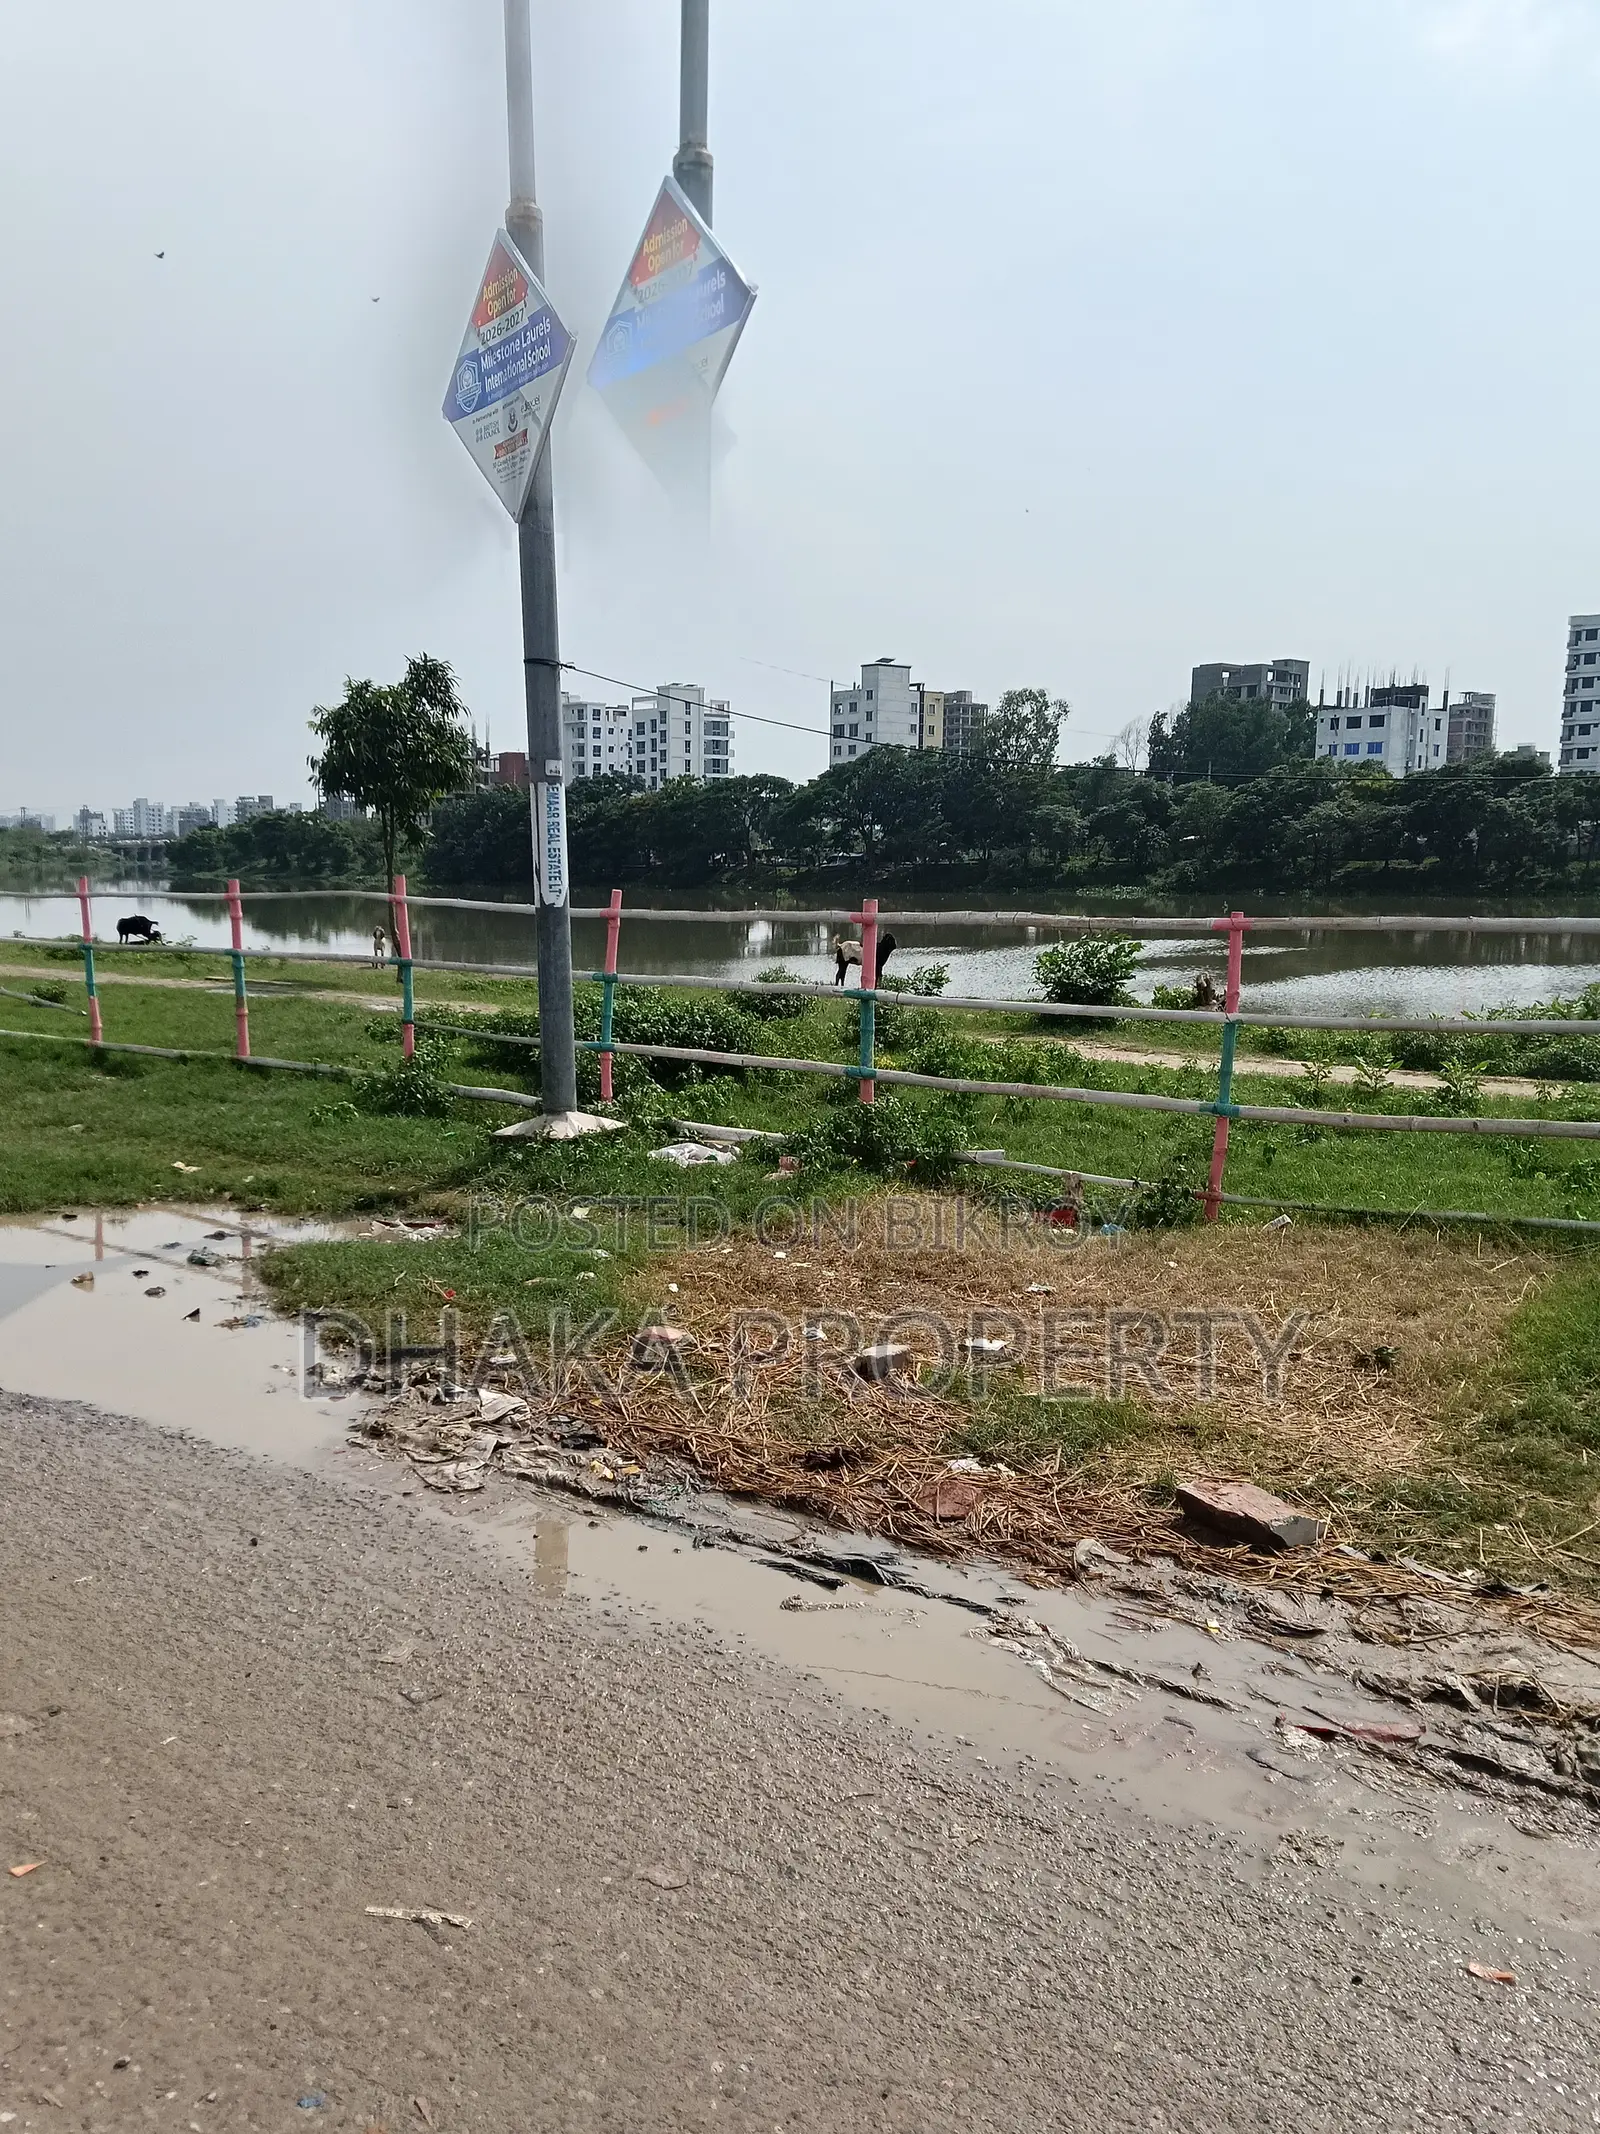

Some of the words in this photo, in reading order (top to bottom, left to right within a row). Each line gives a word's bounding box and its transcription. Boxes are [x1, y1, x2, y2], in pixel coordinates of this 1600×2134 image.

[643, 218, 688, 256] Admission
[483, 267, 518, 301] Admission
[488, 294, 507, 319] Open
[507, 287, 516, 305] for
[481, 307, 524, 345] 2026-2027
[481, 337, 520, 373] Milestone
[522, 315, 551, 348] Laurels
[485, 350, 528, 393] International
[528, 338, 551, 368] School
[546, 786, 560, 818] EMAAR
[546, 820, 560, 845] REAL
[547, 847, 562, 880] ESTATE
